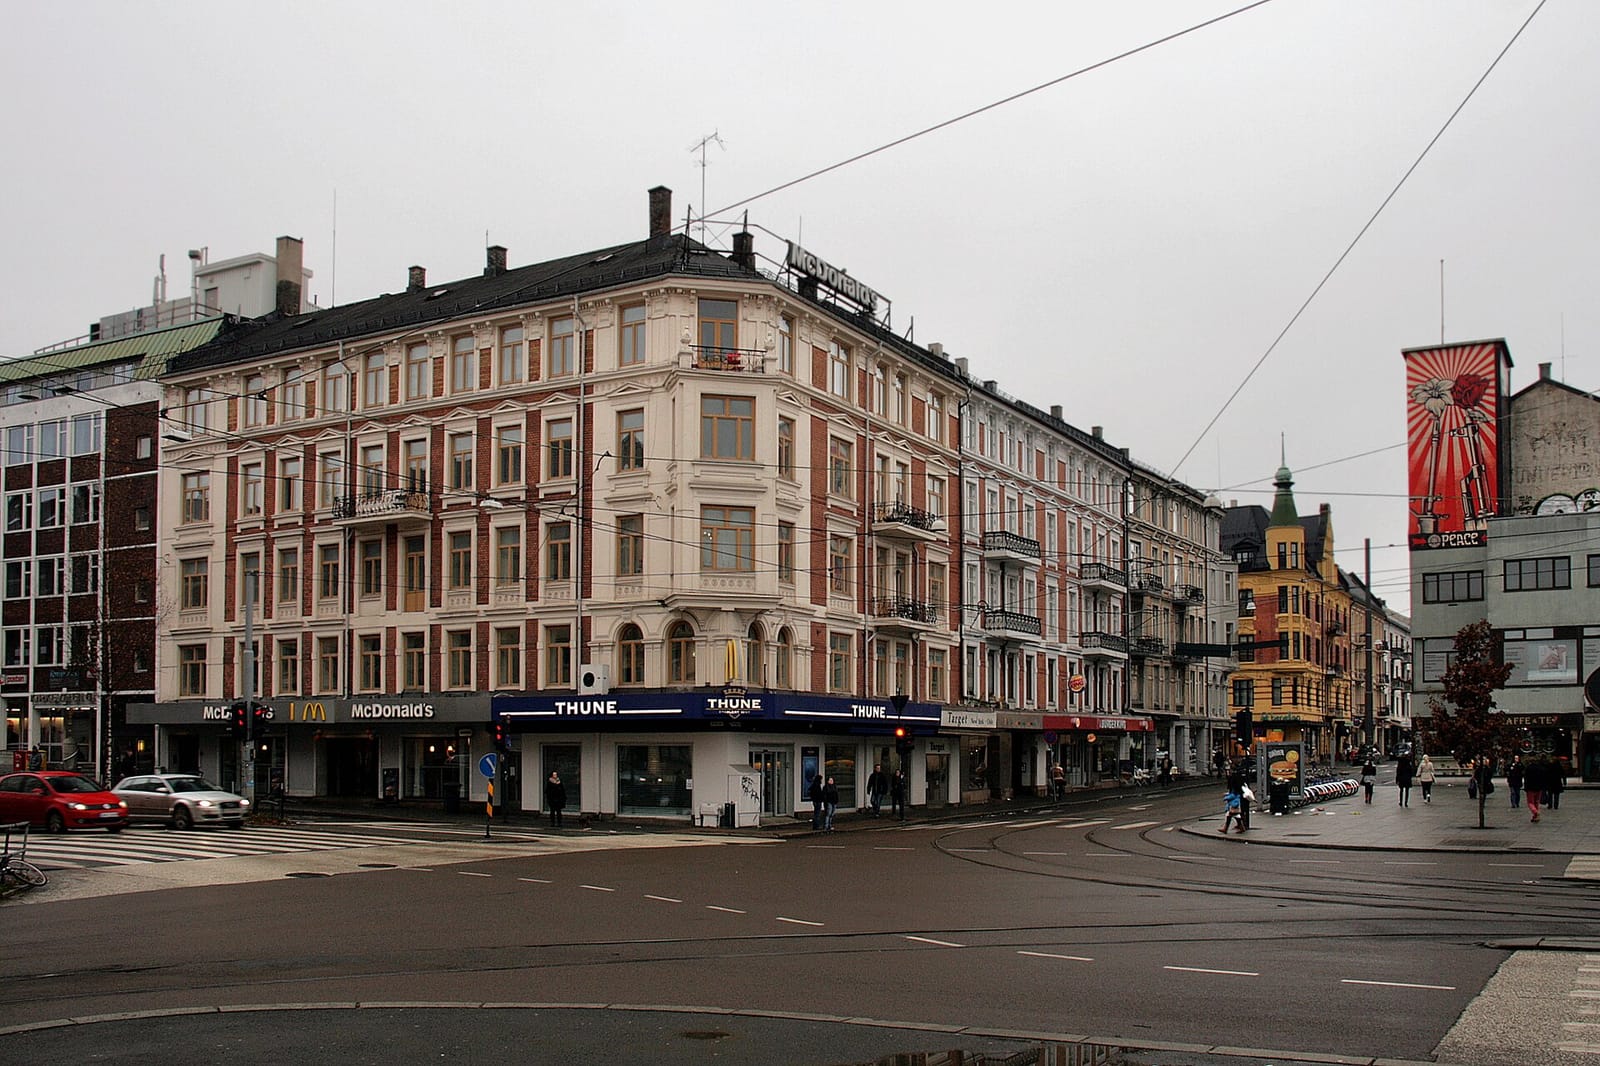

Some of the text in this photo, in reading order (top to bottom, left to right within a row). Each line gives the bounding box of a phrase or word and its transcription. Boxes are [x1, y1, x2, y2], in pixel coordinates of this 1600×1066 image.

[791, 243, 879, 309] McDonald's
[1441, 532, 1479, 547] PEACE
[351, 702, 434, 719] McDonald's
[554, 700, 618, 715] THUNE
[707, 698, 762, 709] THUNE
[851, 704, 886, 719] THUNE
[948, 712, 968, 726] Target
[1503, 716, 1531, 725] AFFE
